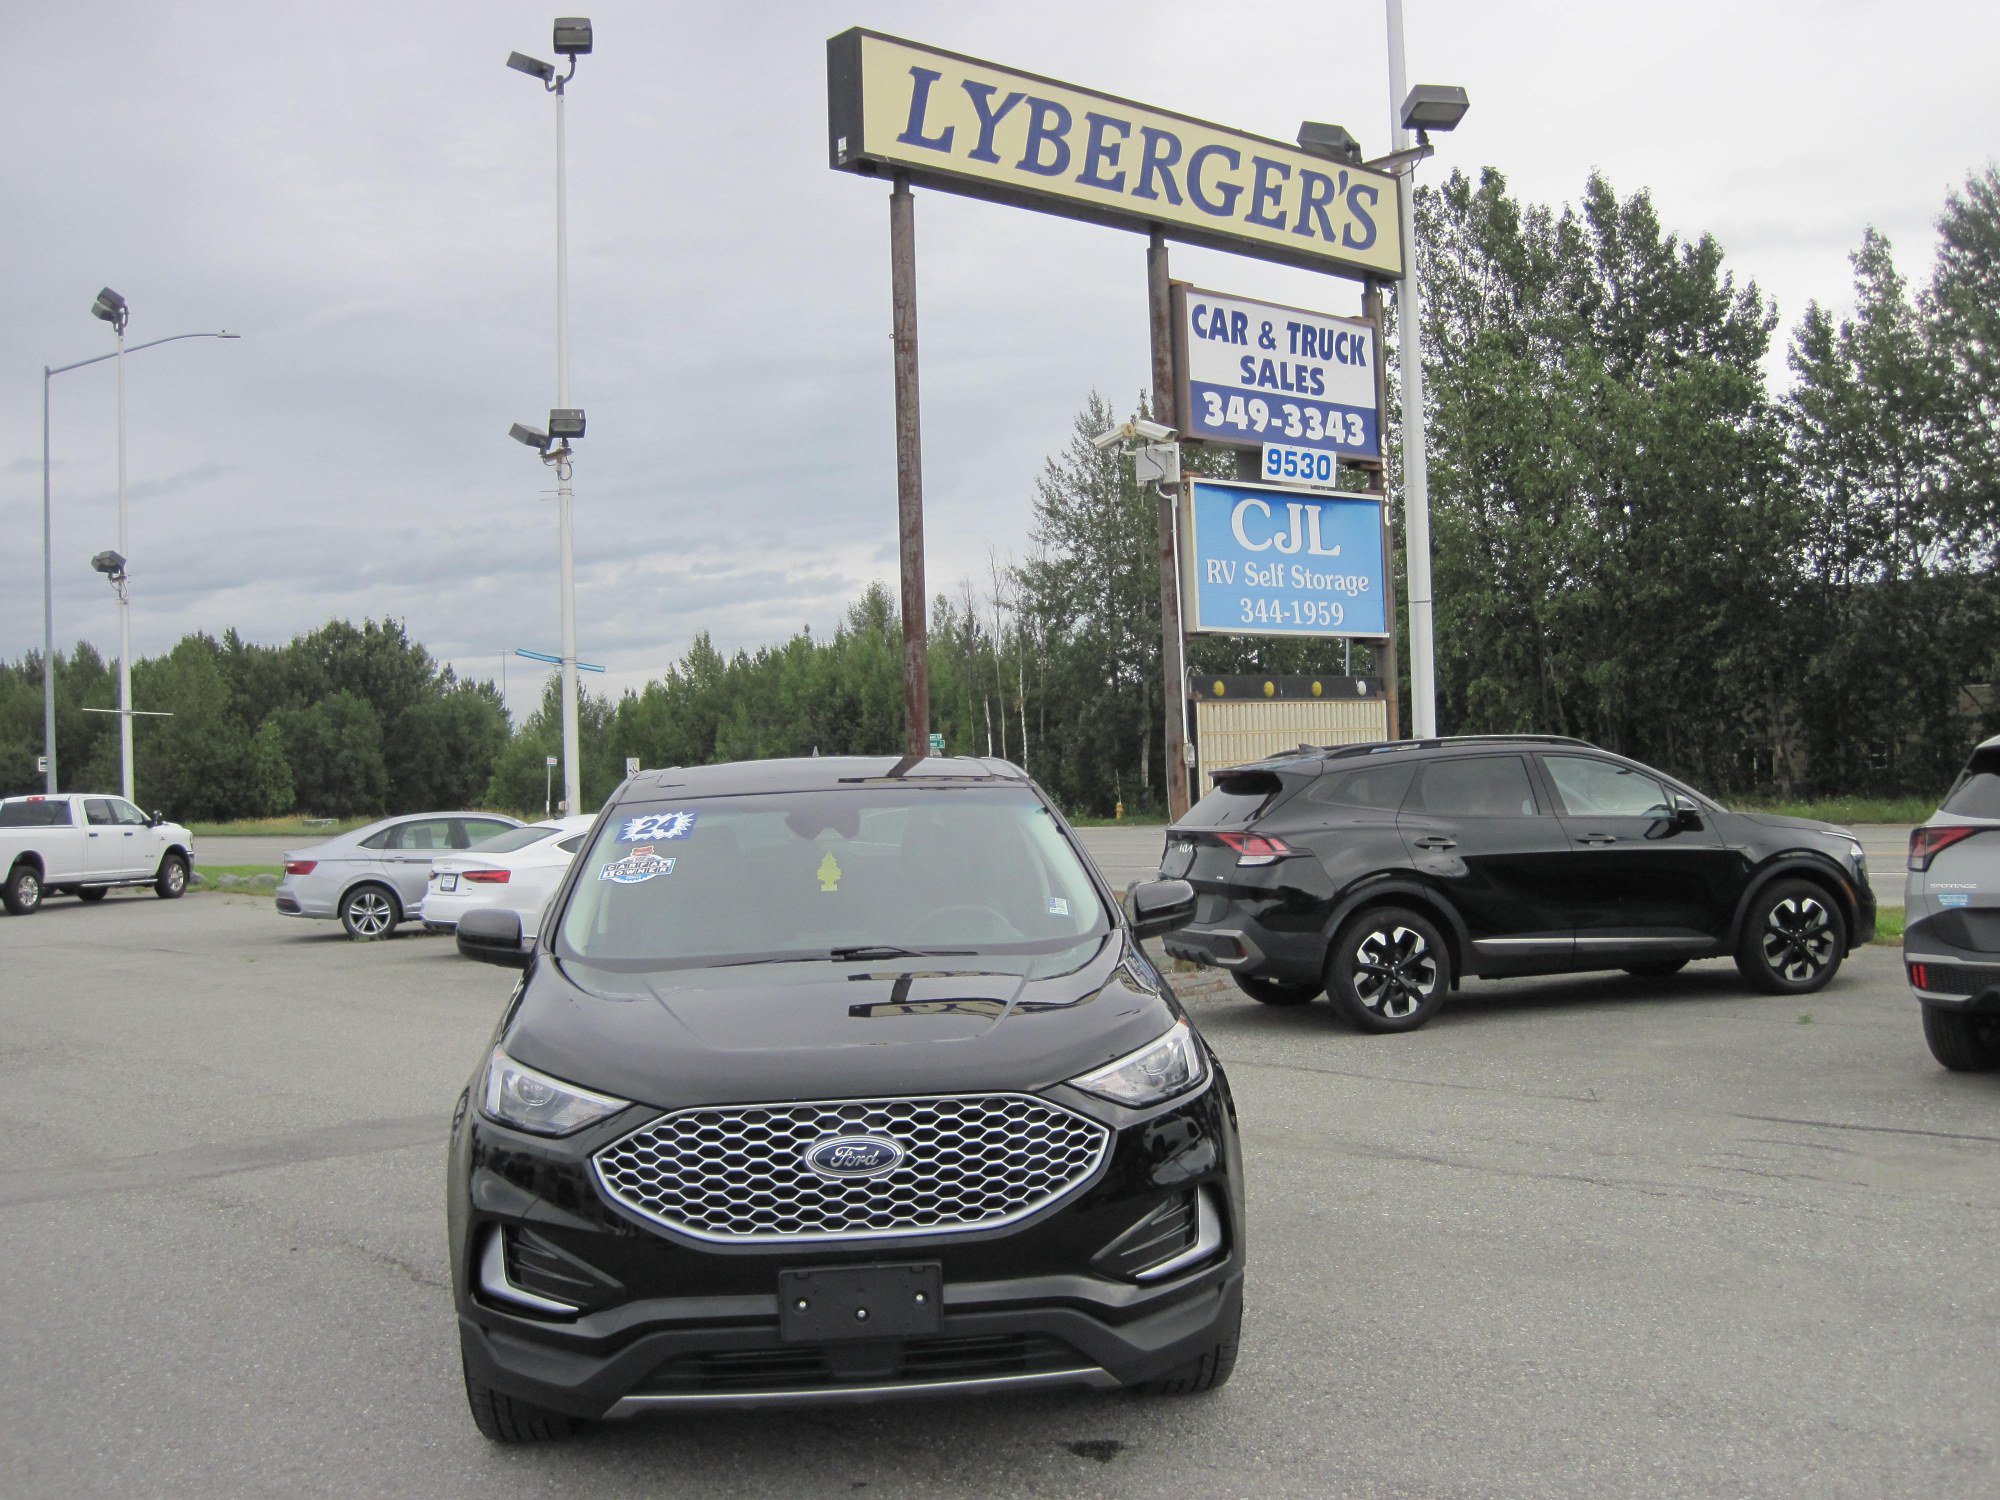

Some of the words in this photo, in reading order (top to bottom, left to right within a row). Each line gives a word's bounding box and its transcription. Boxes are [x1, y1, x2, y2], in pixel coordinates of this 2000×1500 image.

[897, 66, 1379, 251] LYBERGER'S
[1191, 304, 1248, 346] CAR
[1258, 321, 1277, 350] &
[1286, 321, 1367, 367] TRUCK
[1240, 355, 1325, 396] SALES
[1202, 391, 1365, 446] 349-3343
[1266, 448, 1331, 481] 9530
[1231, 499, 1341, 556] CJL
[1206, 559, 1236, 585] RV
[1244, 562, 1284, 588] Self
[1291, 565, 1370, 597] Storage
[1240, 598, 1344, 626] 344-1959
[635, 816, 678, 835] 24
[830, 1146, 879, 1167] Ford
